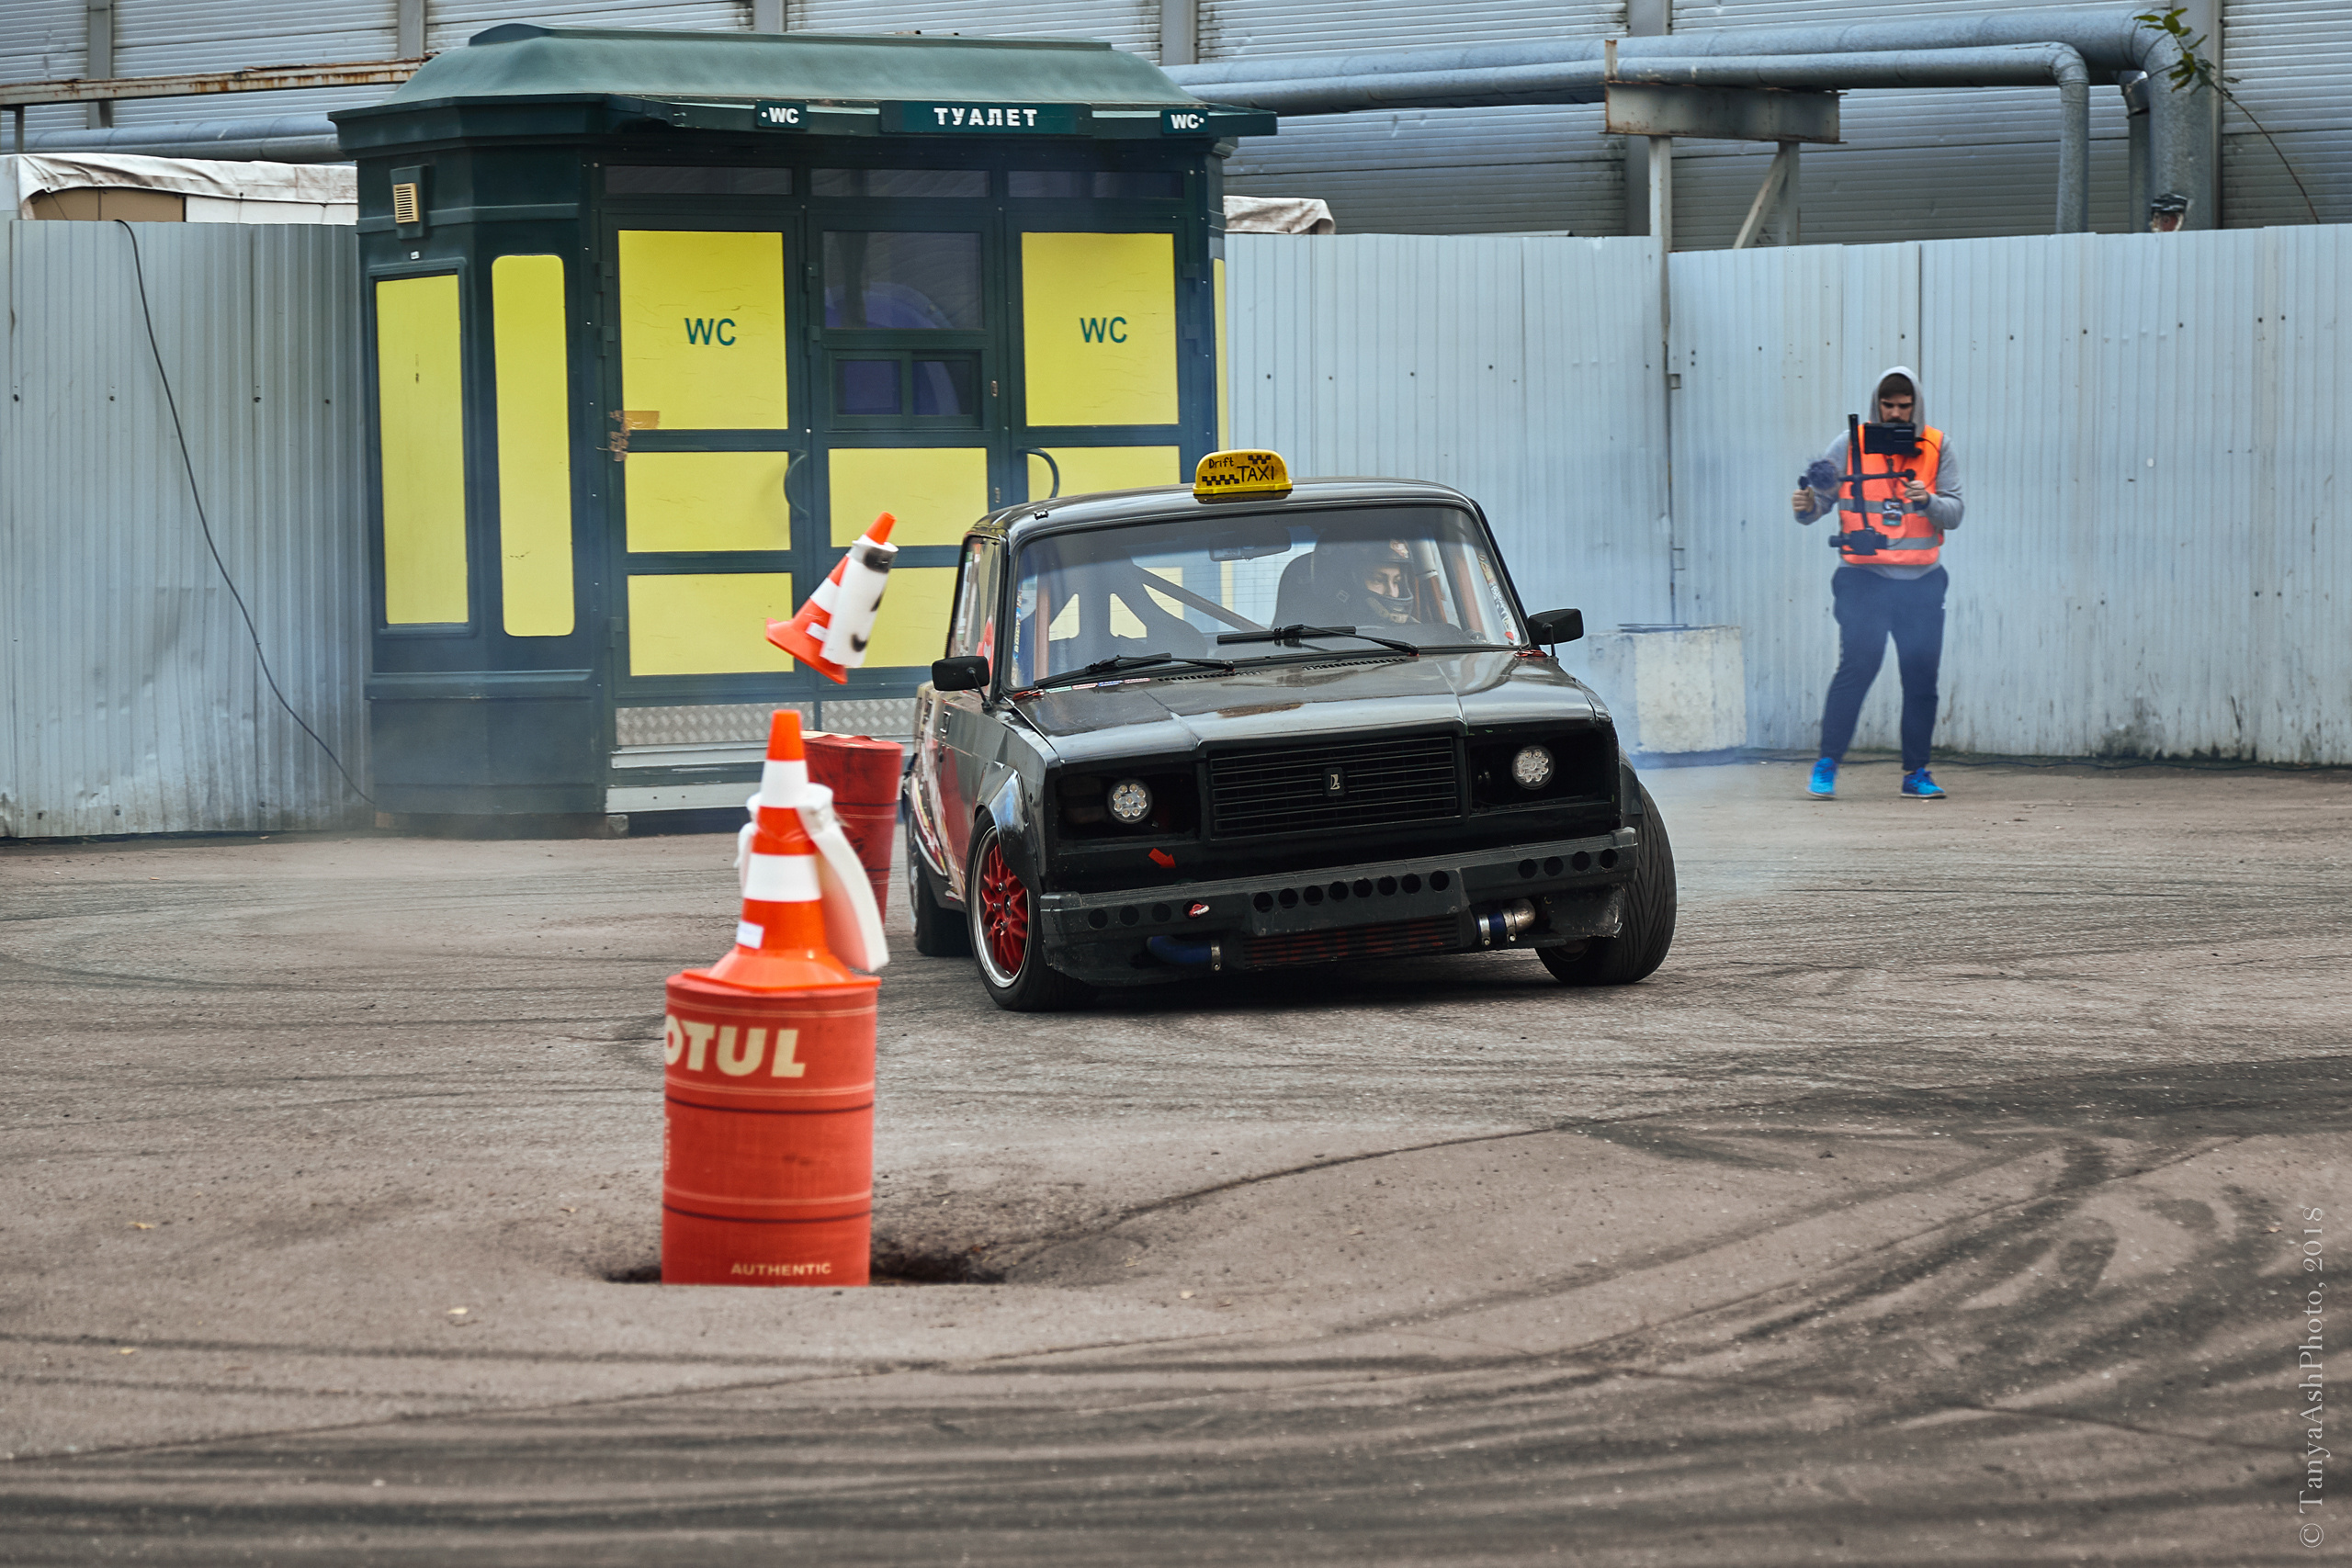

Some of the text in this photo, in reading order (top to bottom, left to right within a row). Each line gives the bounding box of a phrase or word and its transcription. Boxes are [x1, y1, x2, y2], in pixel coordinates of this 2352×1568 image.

[768, 107, 799, 124] WC
[933, 107, 1037, 127] ТУАЛЕТ
[1170, 113, 1200, 130] WC
[684, 317, 736, 346] WC
[1080, 316, 1127, 344] WC
[1208, 457, 1235, 469] Drift
[1237, 465, 1274, 483] TAXI
[730, 1261, 832, 1277] AUTHENTIC
